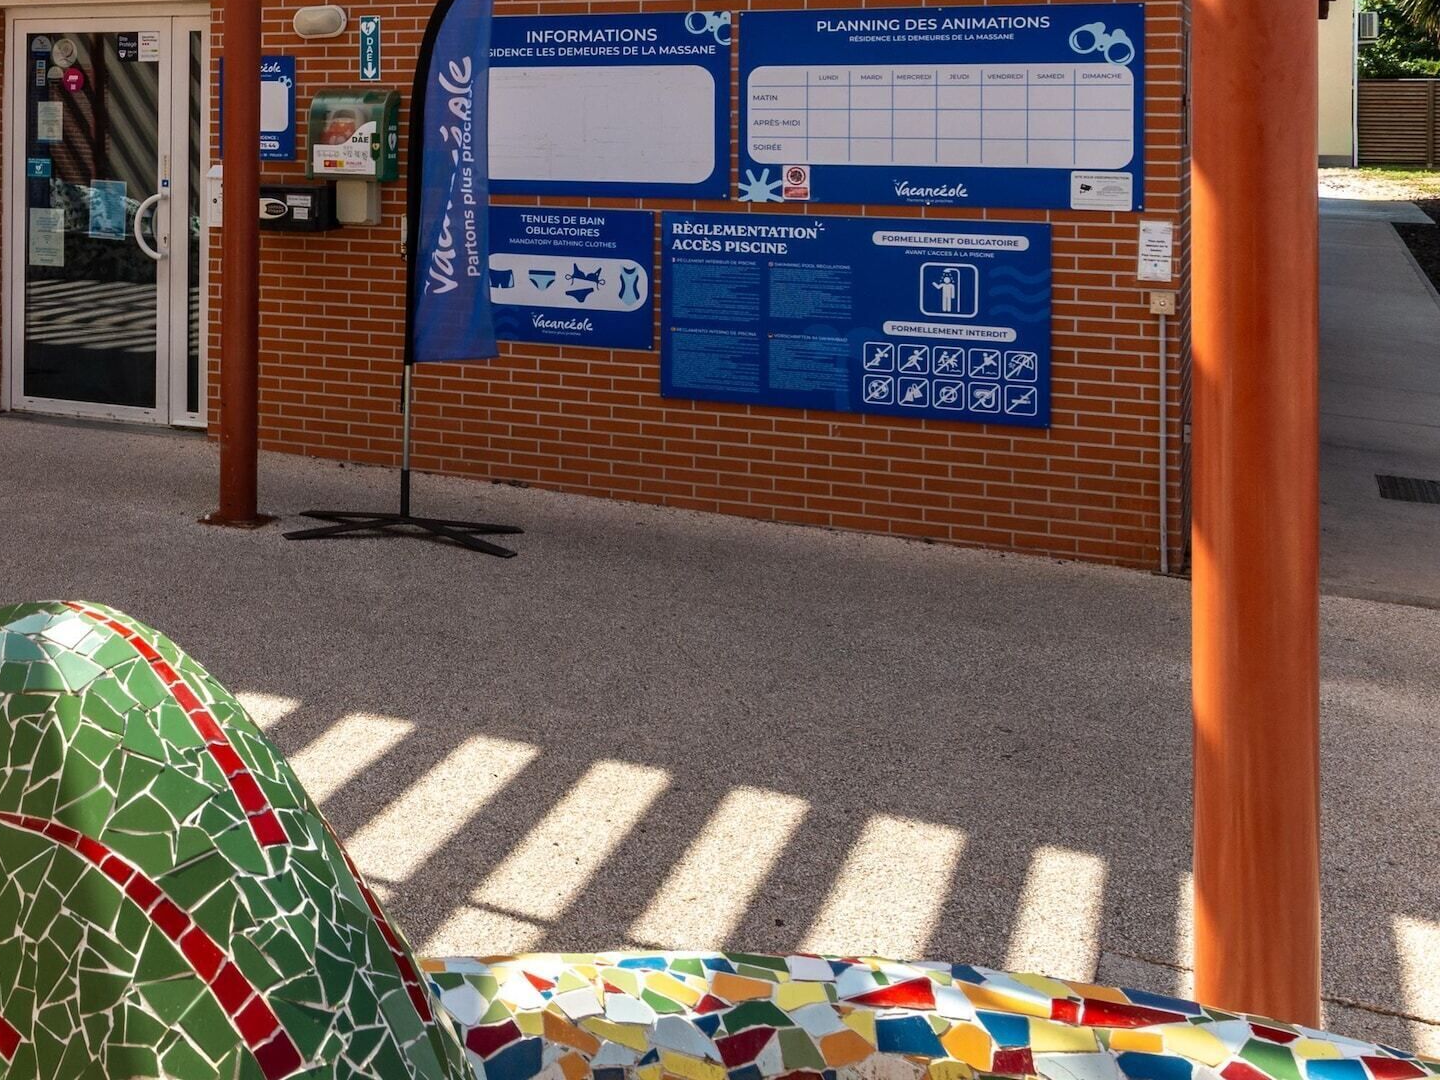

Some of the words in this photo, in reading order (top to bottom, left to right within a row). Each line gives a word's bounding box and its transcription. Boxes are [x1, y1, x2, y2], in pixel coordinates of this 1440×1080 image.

[817, 19, 900, 32] PLANNING
[905, 18, 937, 31] DES
[942, 16, 1050, 30] ANIMATIONS
[527, 28, 658, 43] INFORMATIONS
[849, 34, 891, 42] RÉSIDENCE
[366, 37, 374, 62] DAE
[489, 48, 533, 57] SIDENCE
[536, 47, 555, 57] LES
[558, 46, 620, 56] DEMEURES
[622, 46, 639, 55] DE
[641, 46, 656, 55] LA
[659, 45, 716, 55] MASSANE
[753, 142, 782, 151] SOIRÉE
[461, 167, 476, 205] plus
[895, 181, 968, 197] Vacancéole
[521, 214, 560, 224] TENUES
[563, 215, 577, 225] DE
[579, 216, 605, 225] BAIN
[525, 226, 600, 237] OBLIGATOIRES
[672, 221, 816, 239] RÈGLEMENTATION
[463, 210, 480, 276] Partons
[509, 238, 552, 246] MANDATORY
[585, 241, 616, 249] CLOTHES
[672, 238, 721, 252] ACCÈS
[725, 241, 788, 255] PISCINE
[882, 235, 955, 245] FORMELLEMENT
[957, 237, 1019, 247] OBLIGATOIRE
[532, 314, 593, 331] Vacancéole
[892, 324, 963, 336] FORMELLEMENT
[966, 329, 1008, 338] INTERDIT
